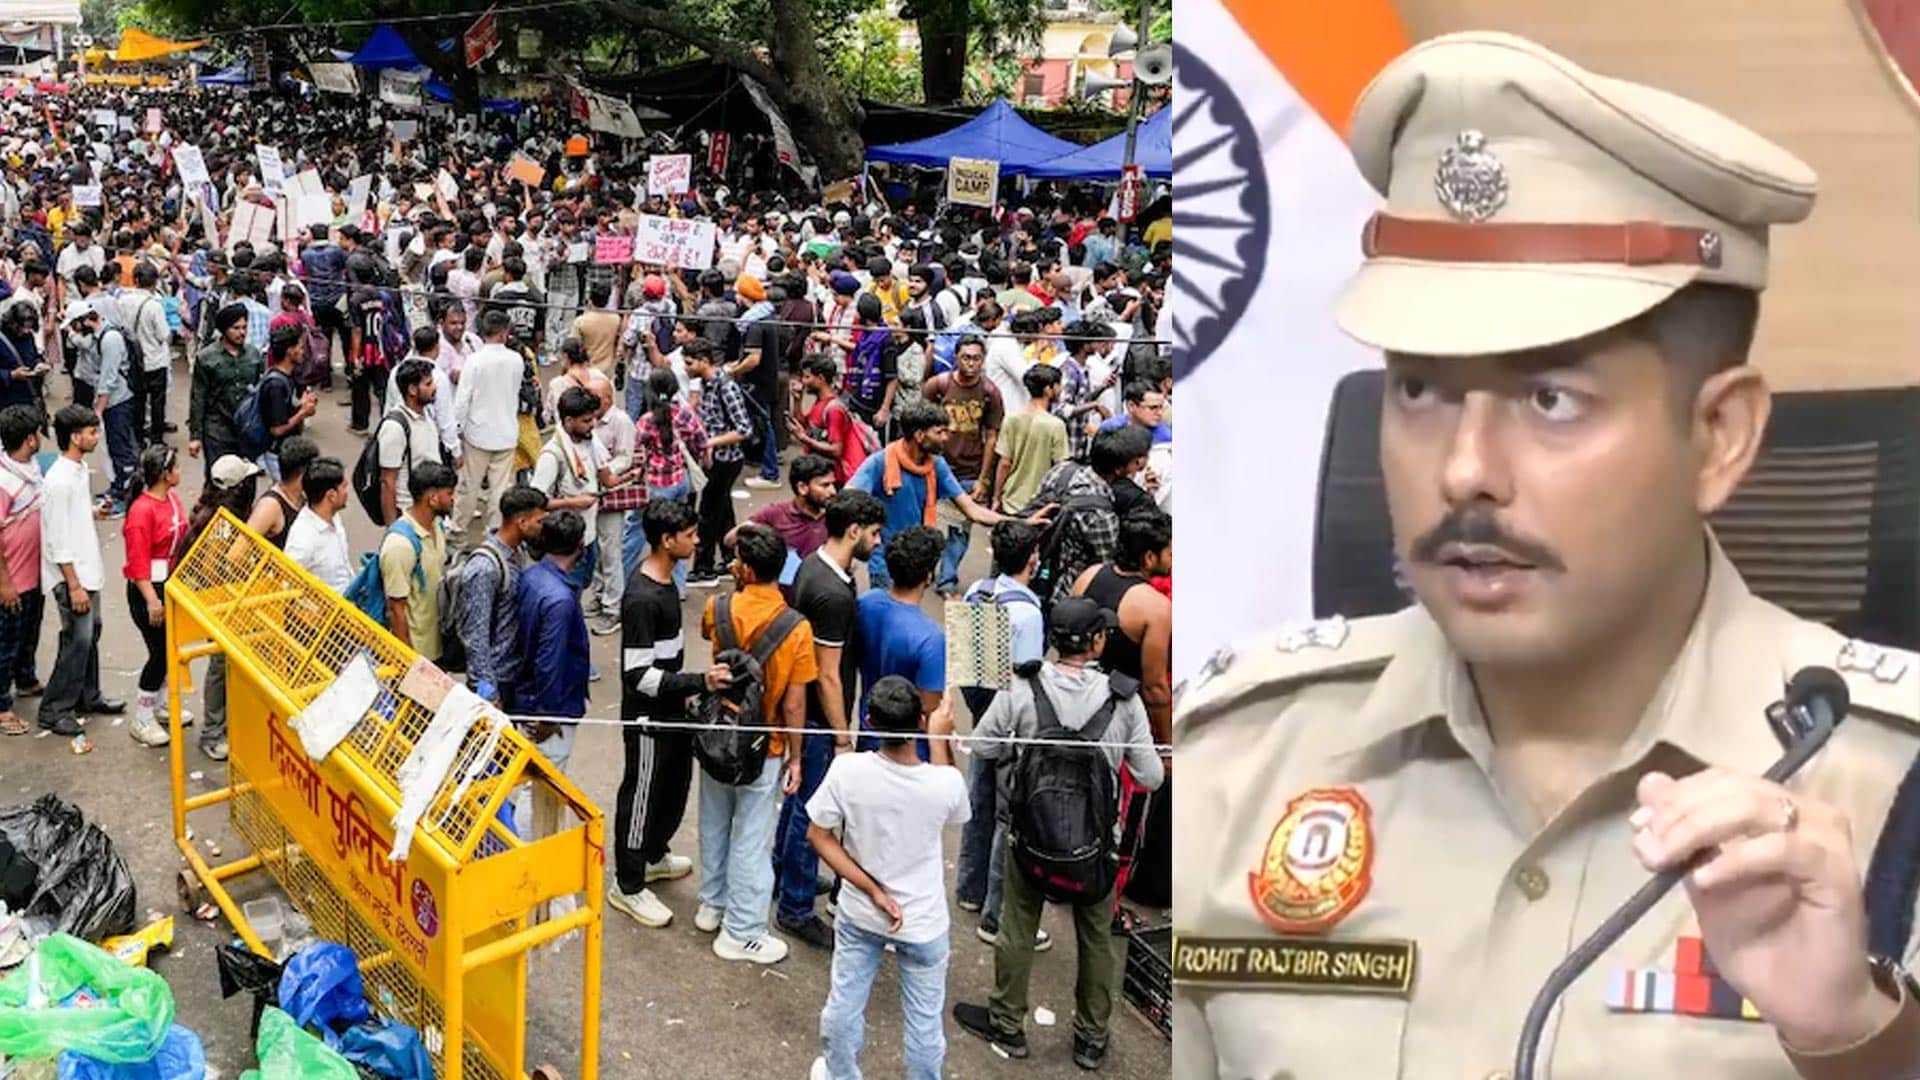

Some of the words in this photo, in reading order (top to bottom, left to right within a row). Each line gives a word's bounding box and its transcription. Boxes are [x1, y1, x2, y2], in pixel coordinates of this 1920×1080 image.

[955, 178, 990, 195] CAMP
[267, 711, 321, 816] दिल्ली
[326, 788, 407, 908] पुलिस
[1178, 945, 1244, 973] ROHIT
[1248, 947, 1330, 976] RAJBIR
[1332, 951, 1405, 980] SINGH
